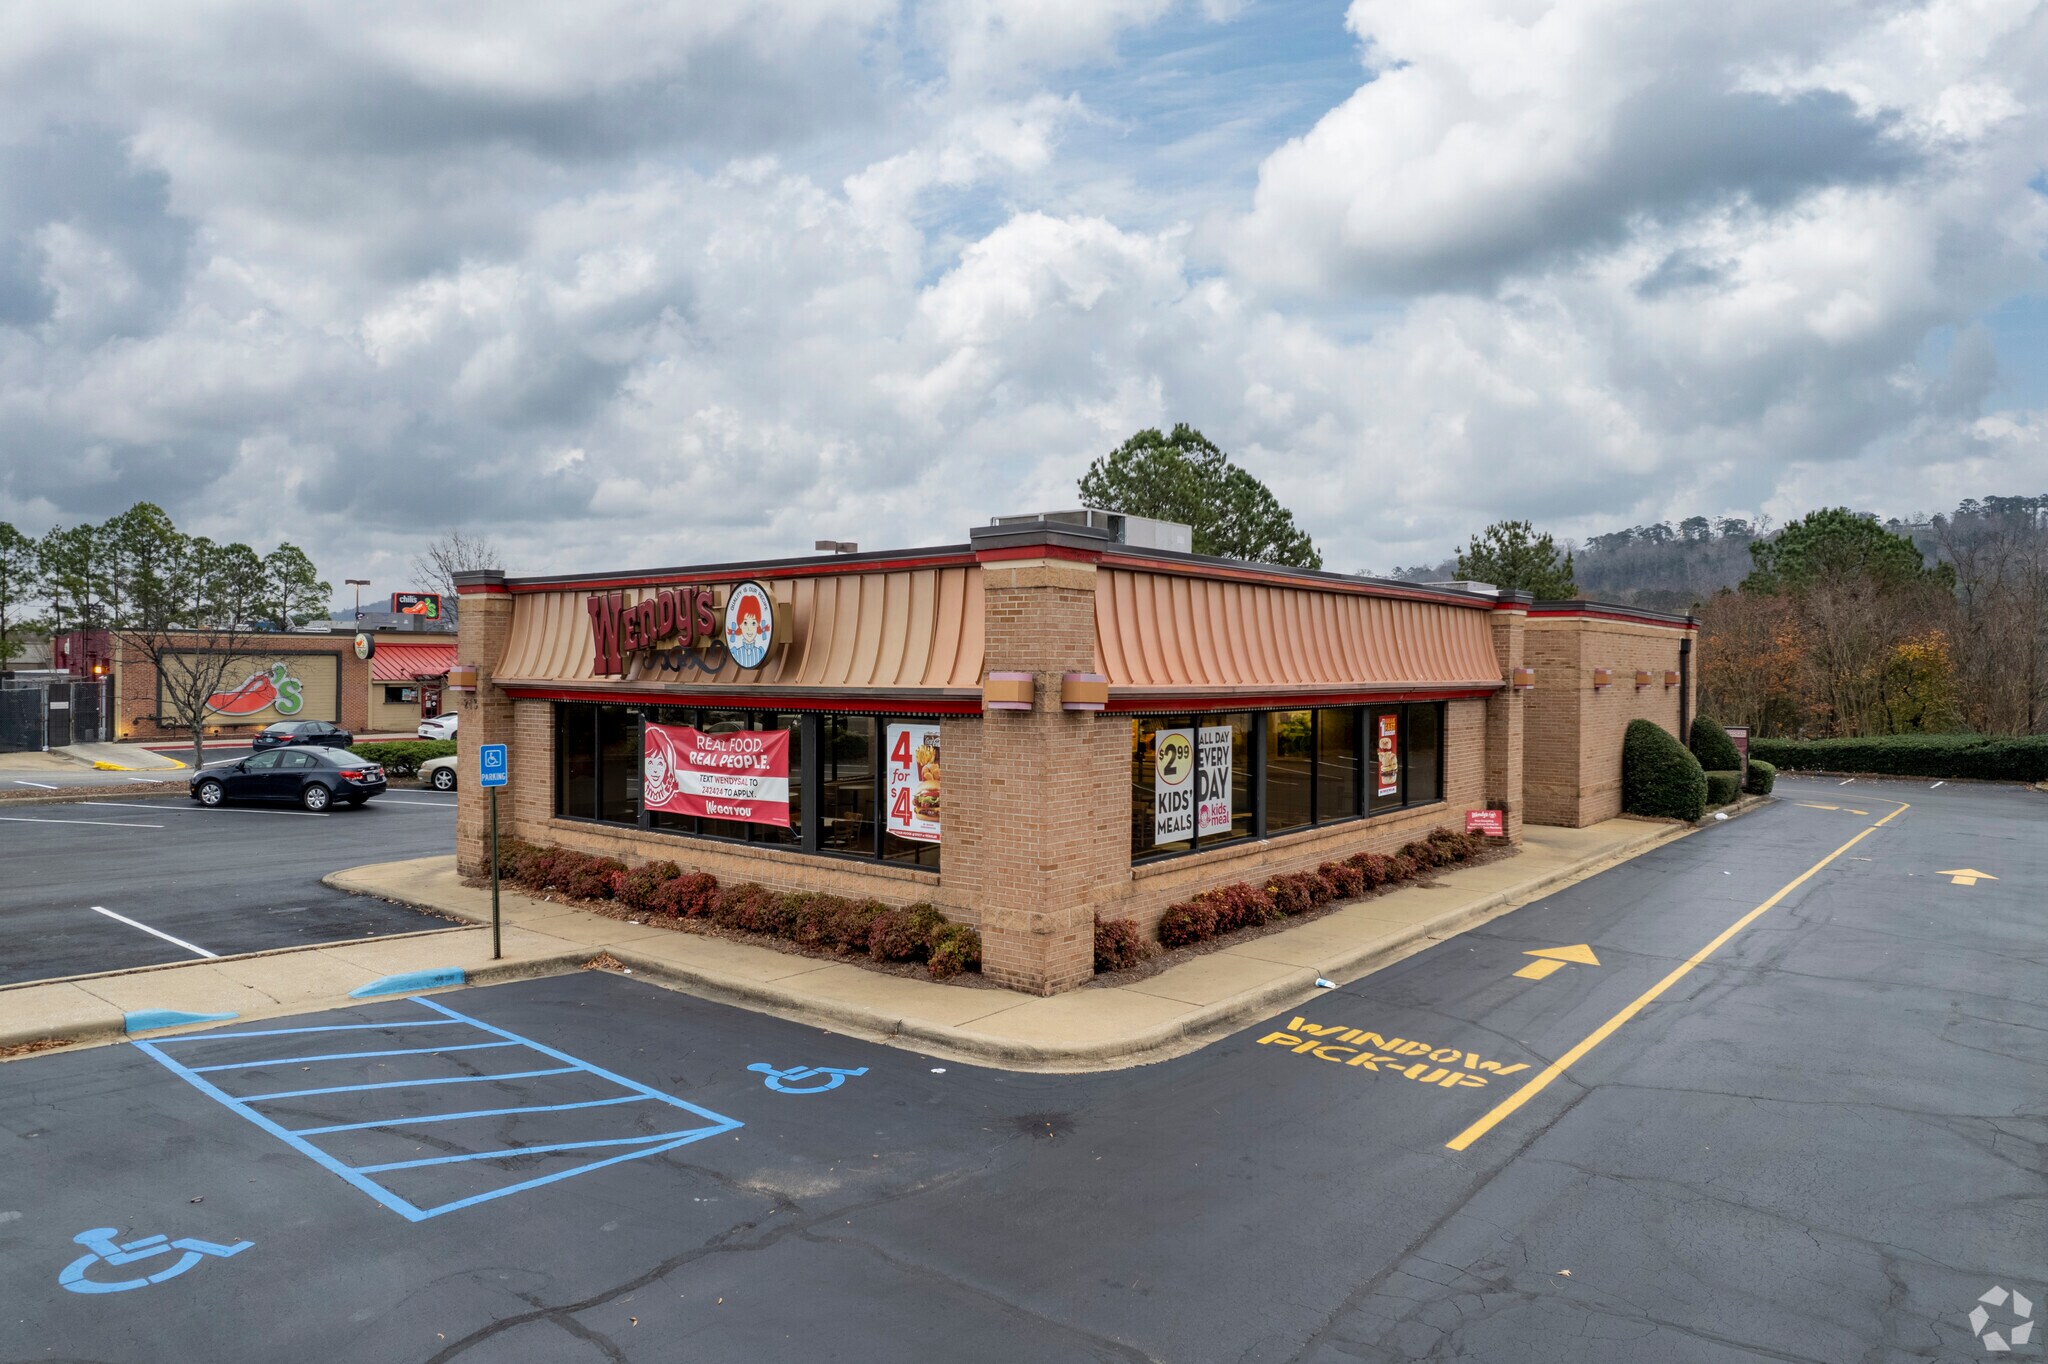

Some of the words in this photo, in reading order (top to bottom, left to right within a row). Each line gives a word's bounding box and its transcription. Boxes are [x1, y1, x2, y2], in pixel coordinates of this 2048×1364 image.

[697, 735, 727, 751] REAL
[728, 738, 764, 752] FOOD.
[1199, 733, 1213, 745] ALL
[1215, 731, 1230, 743] DAY
[890, 731, 913, 769] 4
[1199, 746, 1230, 767] EVERY
[689, 751, 717, 766] REAL
[719, 754, 770, 769] PEOPLE.
[481, 773, 506, 782] PARKING
[700, 774, 714, 783] TEXT
[749, 779, 759, 787] TO
[891, 768, 911, 784] for
[701, 786, 724, 795] 242424
[724, 788, 733, 797] TO
[733, 789, 757, 798] APPLY.
[1199, 767, 1229, 803] DAY
[706, 800, 717, 815] We
[717, 805, 734, 816] GOT
[734, 807, 752, 817] YOU
[890, 787, 913, 827] $4
[1158, 789, 1193, 815] KIDS'
[1211, 803, 1227, 815] kids
[1157, 814, 1192, 836] MEALS
[1211, 812, 1230, 826] meal
[1287, 1016, 1531, 1075] WINDOW
[1256, 1032, 1488, 1088] PICK-UP
